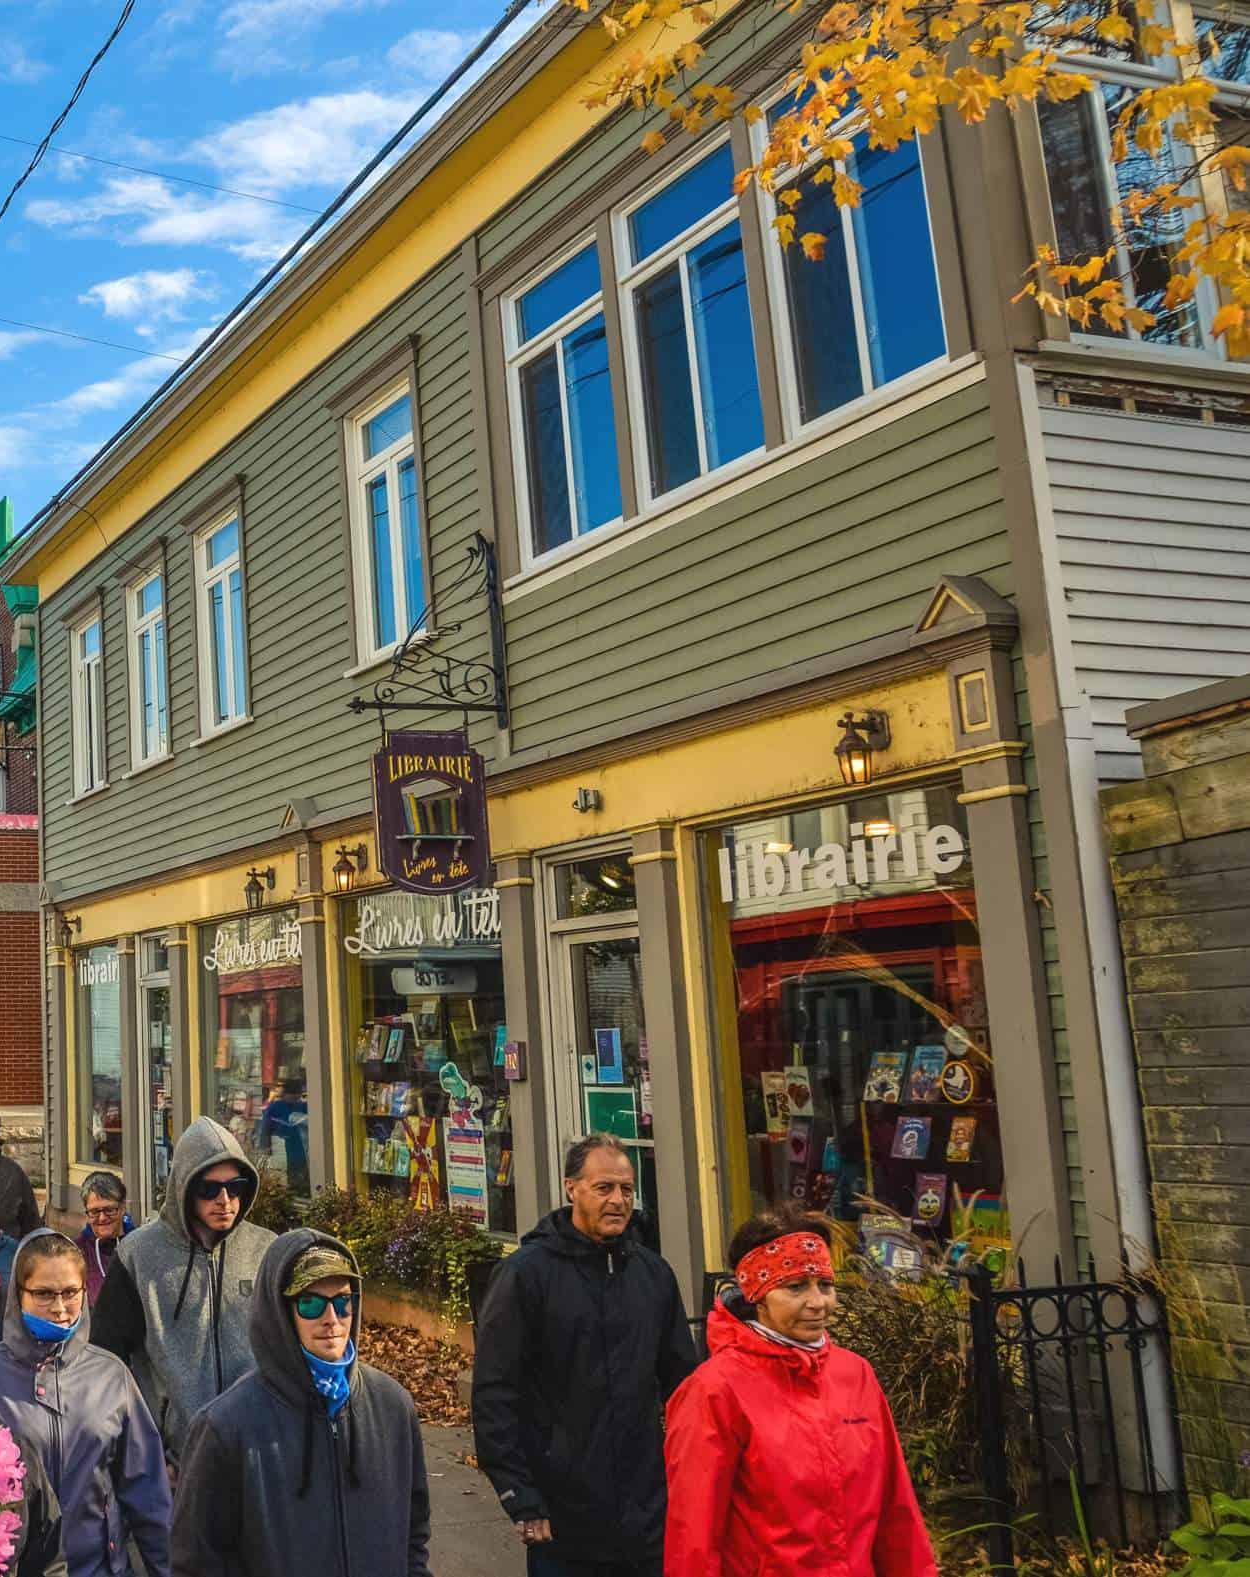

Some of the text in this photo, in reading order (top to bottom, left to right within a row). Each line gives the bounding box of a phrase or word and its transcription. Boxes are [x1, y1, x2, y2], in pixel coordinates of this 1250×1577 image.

[387, 753, 474, 785] LIBRAIRIE
[717, 822, 968, 904] librairie
[203, 929, 258, 971] Livres
[279, 920, 303, 959] têt
[344, 887, 502, 955] Livres en têt
